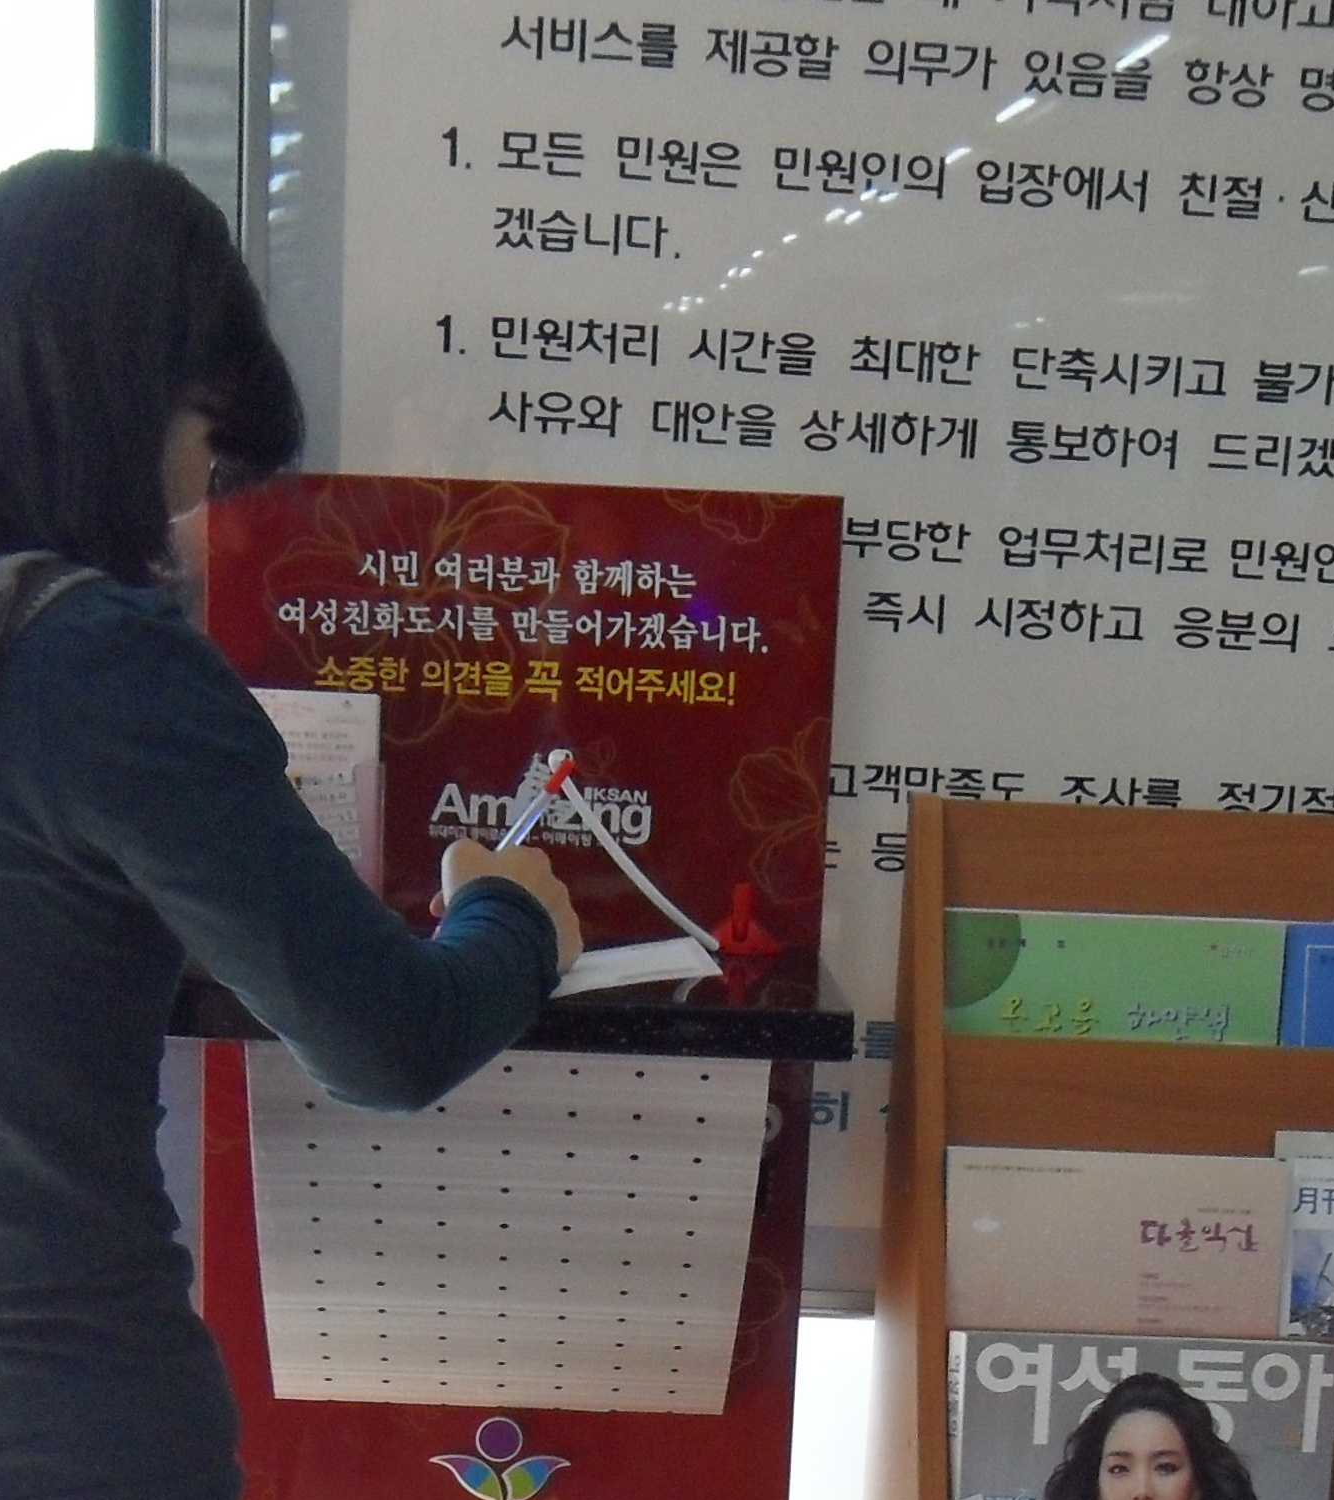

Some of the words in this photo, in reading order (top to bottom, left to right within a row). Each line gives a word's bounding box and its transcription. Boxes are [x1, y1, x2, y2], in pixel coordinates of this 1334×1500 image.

[500, 15, 678, 70] 서비스를
[704, 28, 839, 82] 제공할
[865, 39, 997, 91] 의무가
[1024, 50, 1153, 102] 있음을
[1185, 58, 1274, 110] 항상
[440, 126, 473, 171] 1.
[497, 130, 586, 178] 모든
[615, 134, 743, 190] 민원은
[773, 143, 948, 200] 민원인의
[976, 155, 1150, 213] 입장에서
[493, 206, 682, 260] 겠습니다.
[435, 314, 467, 358] 1.
[490, 315, 660, 368] 민원처리
[688, 325, 818, 380] 시간을
[850, 334, 981, 388] 최대한
[1012, 346, 1227, 399] 단축시키고
[488, 390, 624, 439] 사유와
[651, 398, 777, 450] 대안을
[800, 408, 979, 461] 상세하게
[1005, 419, 1180, 471] 통보하여
[358, 547, 420, 588] 시민
[435, 554, 562, 597] 여러분과
[573, 561, 698, 602] 함께하는
[841, 515, 970, 565] 부당한
[998, 524, 1208, 577] 업무처리로
[278, 599, 500, 643] 여성친화도시를
[511, 606, 769, 656] 만들어가겠습니다.
[863, 591, 948, 638] 즉시
[975, 594, 1145, 645] 시정하고
[1173, 605, 1299, 655] 응분의
[314, 655, 409, 694] 소중한
[422, 658, 514, 699] 의견을
[525, 660, 563, 702] 꼭
[575, 664, 736, 707] 적어주세요!
